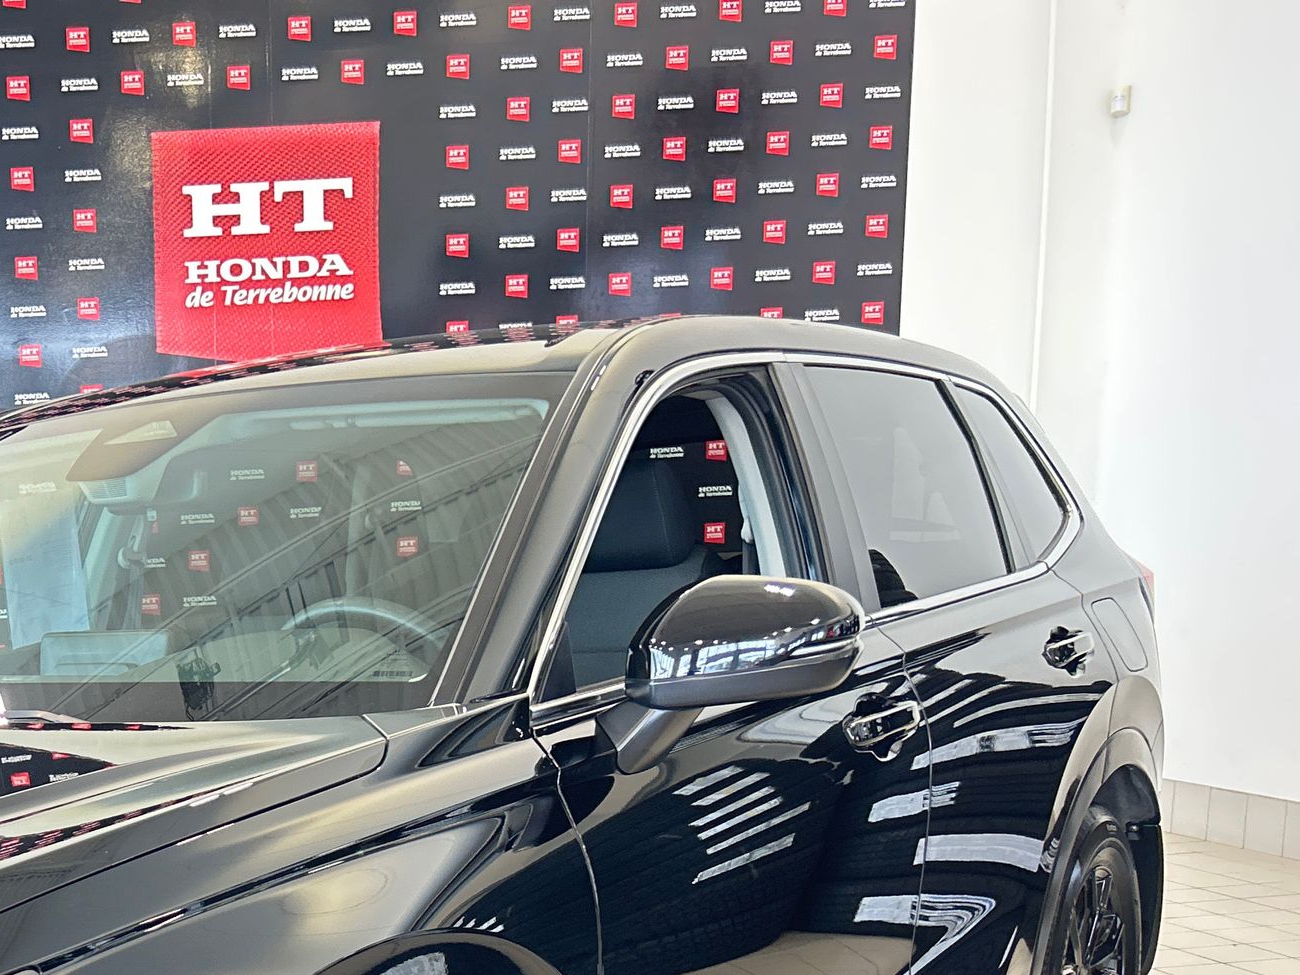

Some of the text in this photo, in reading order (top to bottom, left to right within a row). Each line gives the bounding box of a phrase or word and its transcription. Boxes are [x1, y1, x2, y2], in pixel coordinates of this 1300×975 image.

[765, 0, 801, 8] HONDA
[554, 8, 590, 16] HONDA
[660, 5, 696, 13] HONDA
[440, 14, 476, 22] HONDA
[334, 18, 371, 27] HONDA
[112, 29, 149, 38] HONDA
[815, 43, 851, 51] HONDA
[711, 48, 747, 57] HONDA
[501, 56, 537, 65] HONDA
[387, 62, 423, 71] HONDA
[282, 67, 318, 76] HONDA
[61, 78, 98, 87] HONDA
[865, 86, 901, 94] HONDA
[761, 91, 797, 100] HONDA
[552, 99, 588, 108] HONDA
[658, 96, 694, 105] HONDA
[439, 105, 476, 114] HONDA
[2, 127, 39, 135] HONDA
[811, 134, 847, 142] HONDA
[708, 139, 744, 148] HONDA
[500, 147, 536, 156] HONDA
[604, 145, 640, 153] HONDA
[861, 176, 896, 184] HONDA
[758, 181, 794, 189] HONDA
[551, 189, 587, 197] HONDA
[655, 186, 691, 195] HONDA
[440, 195, 475, 203] HONDA
[182, 177, 353, 238] HT
[6, 217, 42, 225] HONDA
[808, 222, 843, 231] HONDA
[705, 228, 741, 236] HONDA
[499, 235, 535, 244] HONDA
[603, 233, 638, 242] HONDA
[69, 258, 104, 266] HONDA
[184, 254, 354, 284] HONDA
[857, 263, 892, 271] HONDA
[755, 269, 790, 277] HONDA
[550, 277, 585, 285] HONDA
[653, 275, 688, 283] HONDA
[439, 282, 475, 290] HONDA
[185, 282, 354, 308] de Terrebonne
[11, 306, 46, 314] HONDA
[805, 309, 839, 317] HONDA
